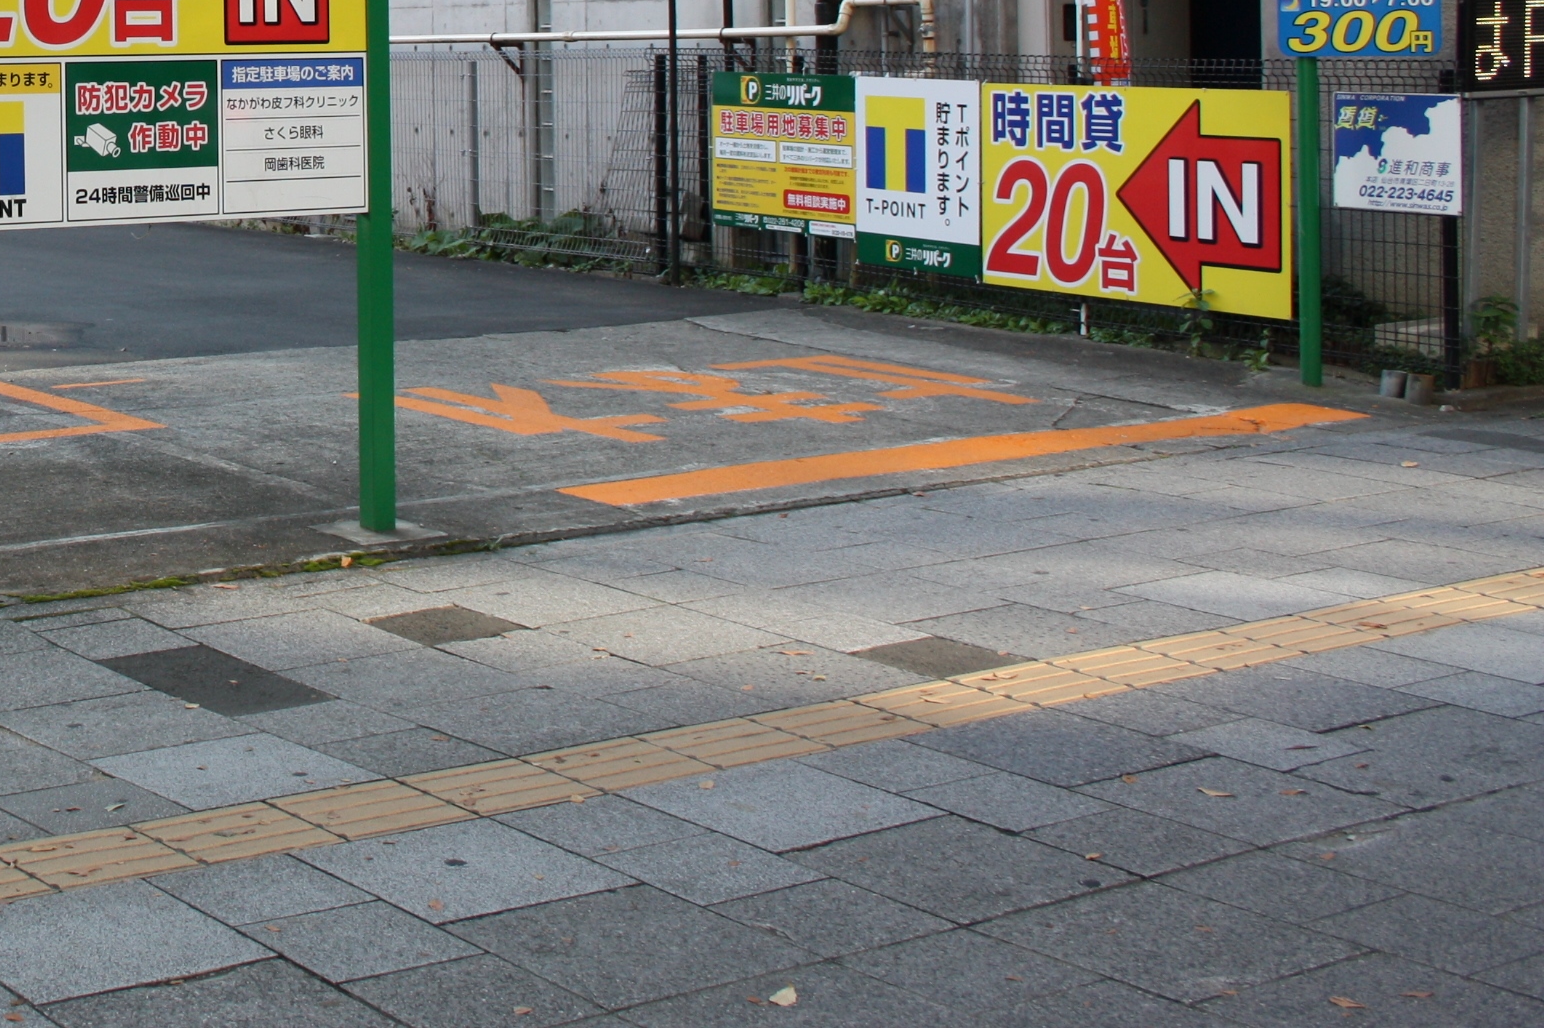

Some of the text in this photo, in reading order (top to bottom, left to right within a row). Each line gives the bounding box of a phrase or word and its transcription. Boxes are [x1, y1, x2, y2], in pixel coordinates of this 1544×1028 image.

[1287, 9, 1433, 53] 300円
[231, 65, 354, 83] 指定駐車場のご案内
[76, 83, 207, 113] 防犯カメラ
[226, 95, 358, 110] なかがわ皮フ科クリニック
[765, 83, 822, 107] 三井のリパーク
[264, 125, 323, 140] さくら眼科
[720, 111, 847, 141] 駐車場用地募集中
[991, 91, 1124, 153] 時間貸
[130, 123, 207, 151] 作動中
[264, 156, 325, 172] 岡歯科医院
[936, 102, 951, 227] 貯まります。
[955, 104, 970, 217] Tポイント
[1388, 159, 1453, 177] 進和商事
[75, 183, 211, 204] 24時間警備巡回中
[787, 193, 847, 211] 無料相談実施中
[1168, 158, 1261, 245] IN
[1359, 185, 1454, 203] 022-223-4645
[866, 198, 926, 219] T-POINT
[985, 159, 1139, 292] 20台
[905, 247, 952, 268] 三井のリパーク
